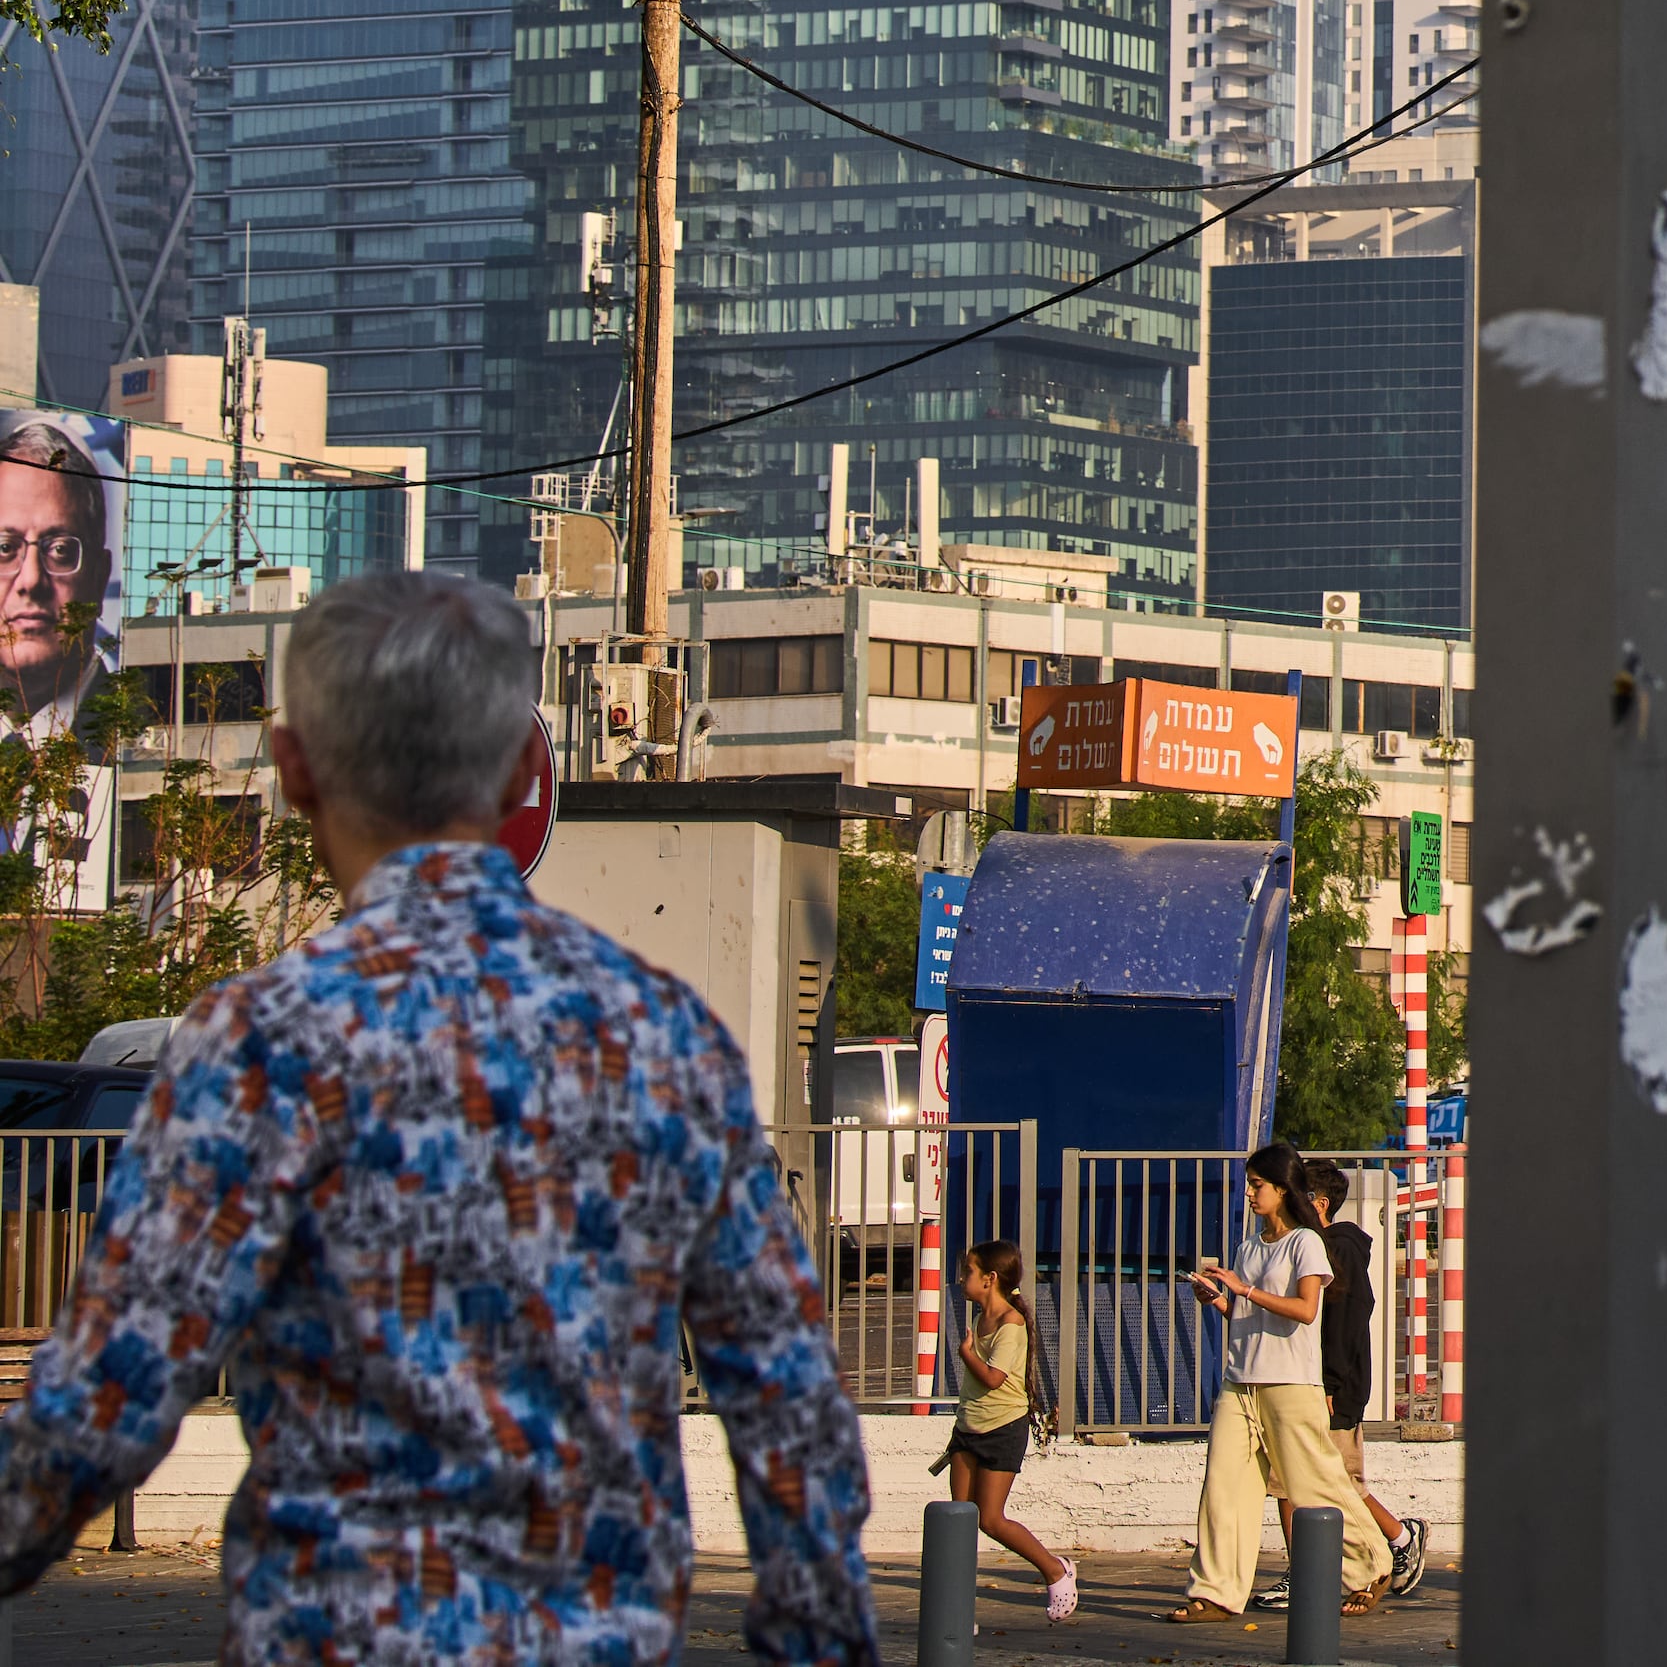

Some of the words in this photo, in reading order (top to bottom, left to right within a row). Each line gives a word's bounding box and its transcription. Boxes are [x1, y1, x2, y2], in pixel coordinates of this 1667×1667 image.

[1064, 697, 1115, 727] עמדת
[1164, 699, 1233, 733] עמדת
[1057, 738, 1117, 771] תשלום
[1159, 739, 1241, 777] תשלום
